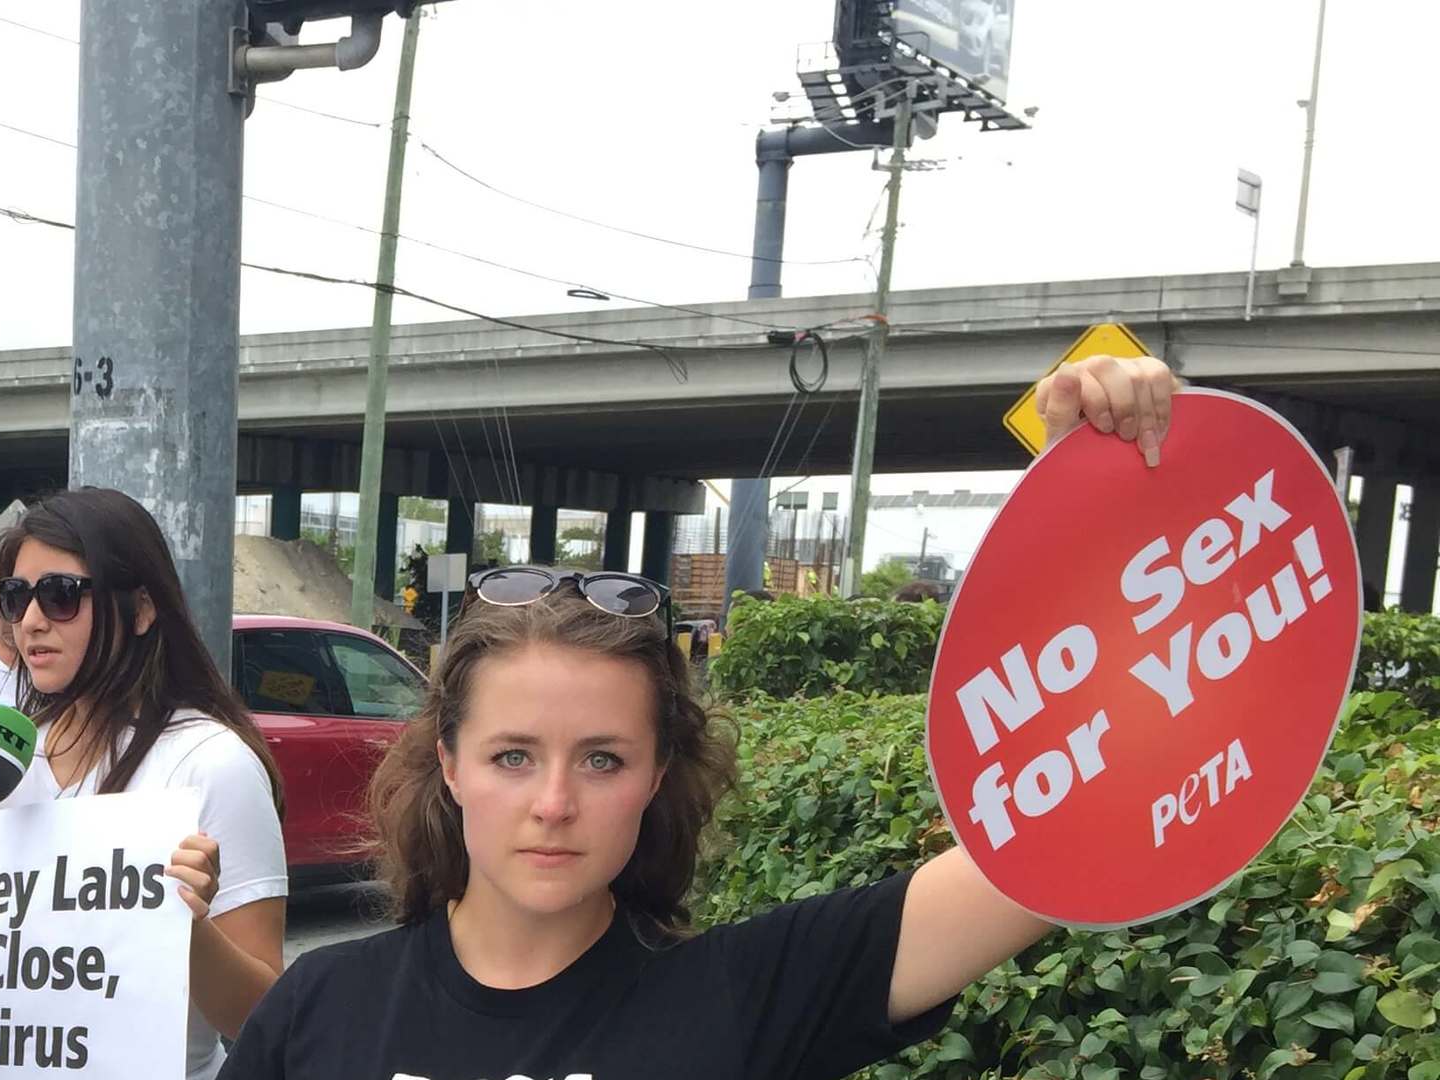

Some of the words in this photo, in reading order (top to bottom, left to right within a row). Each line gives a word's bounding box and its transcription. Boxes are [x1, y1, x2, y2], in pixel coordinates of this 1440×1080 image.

[956, 625, 1098, 756] No
[1120, 469, 1292, 634] Sex
[968, 709, 1111, 851] for
[1128, 526, 1332, 717] You!
[52, 848, 165, 911] Labs
